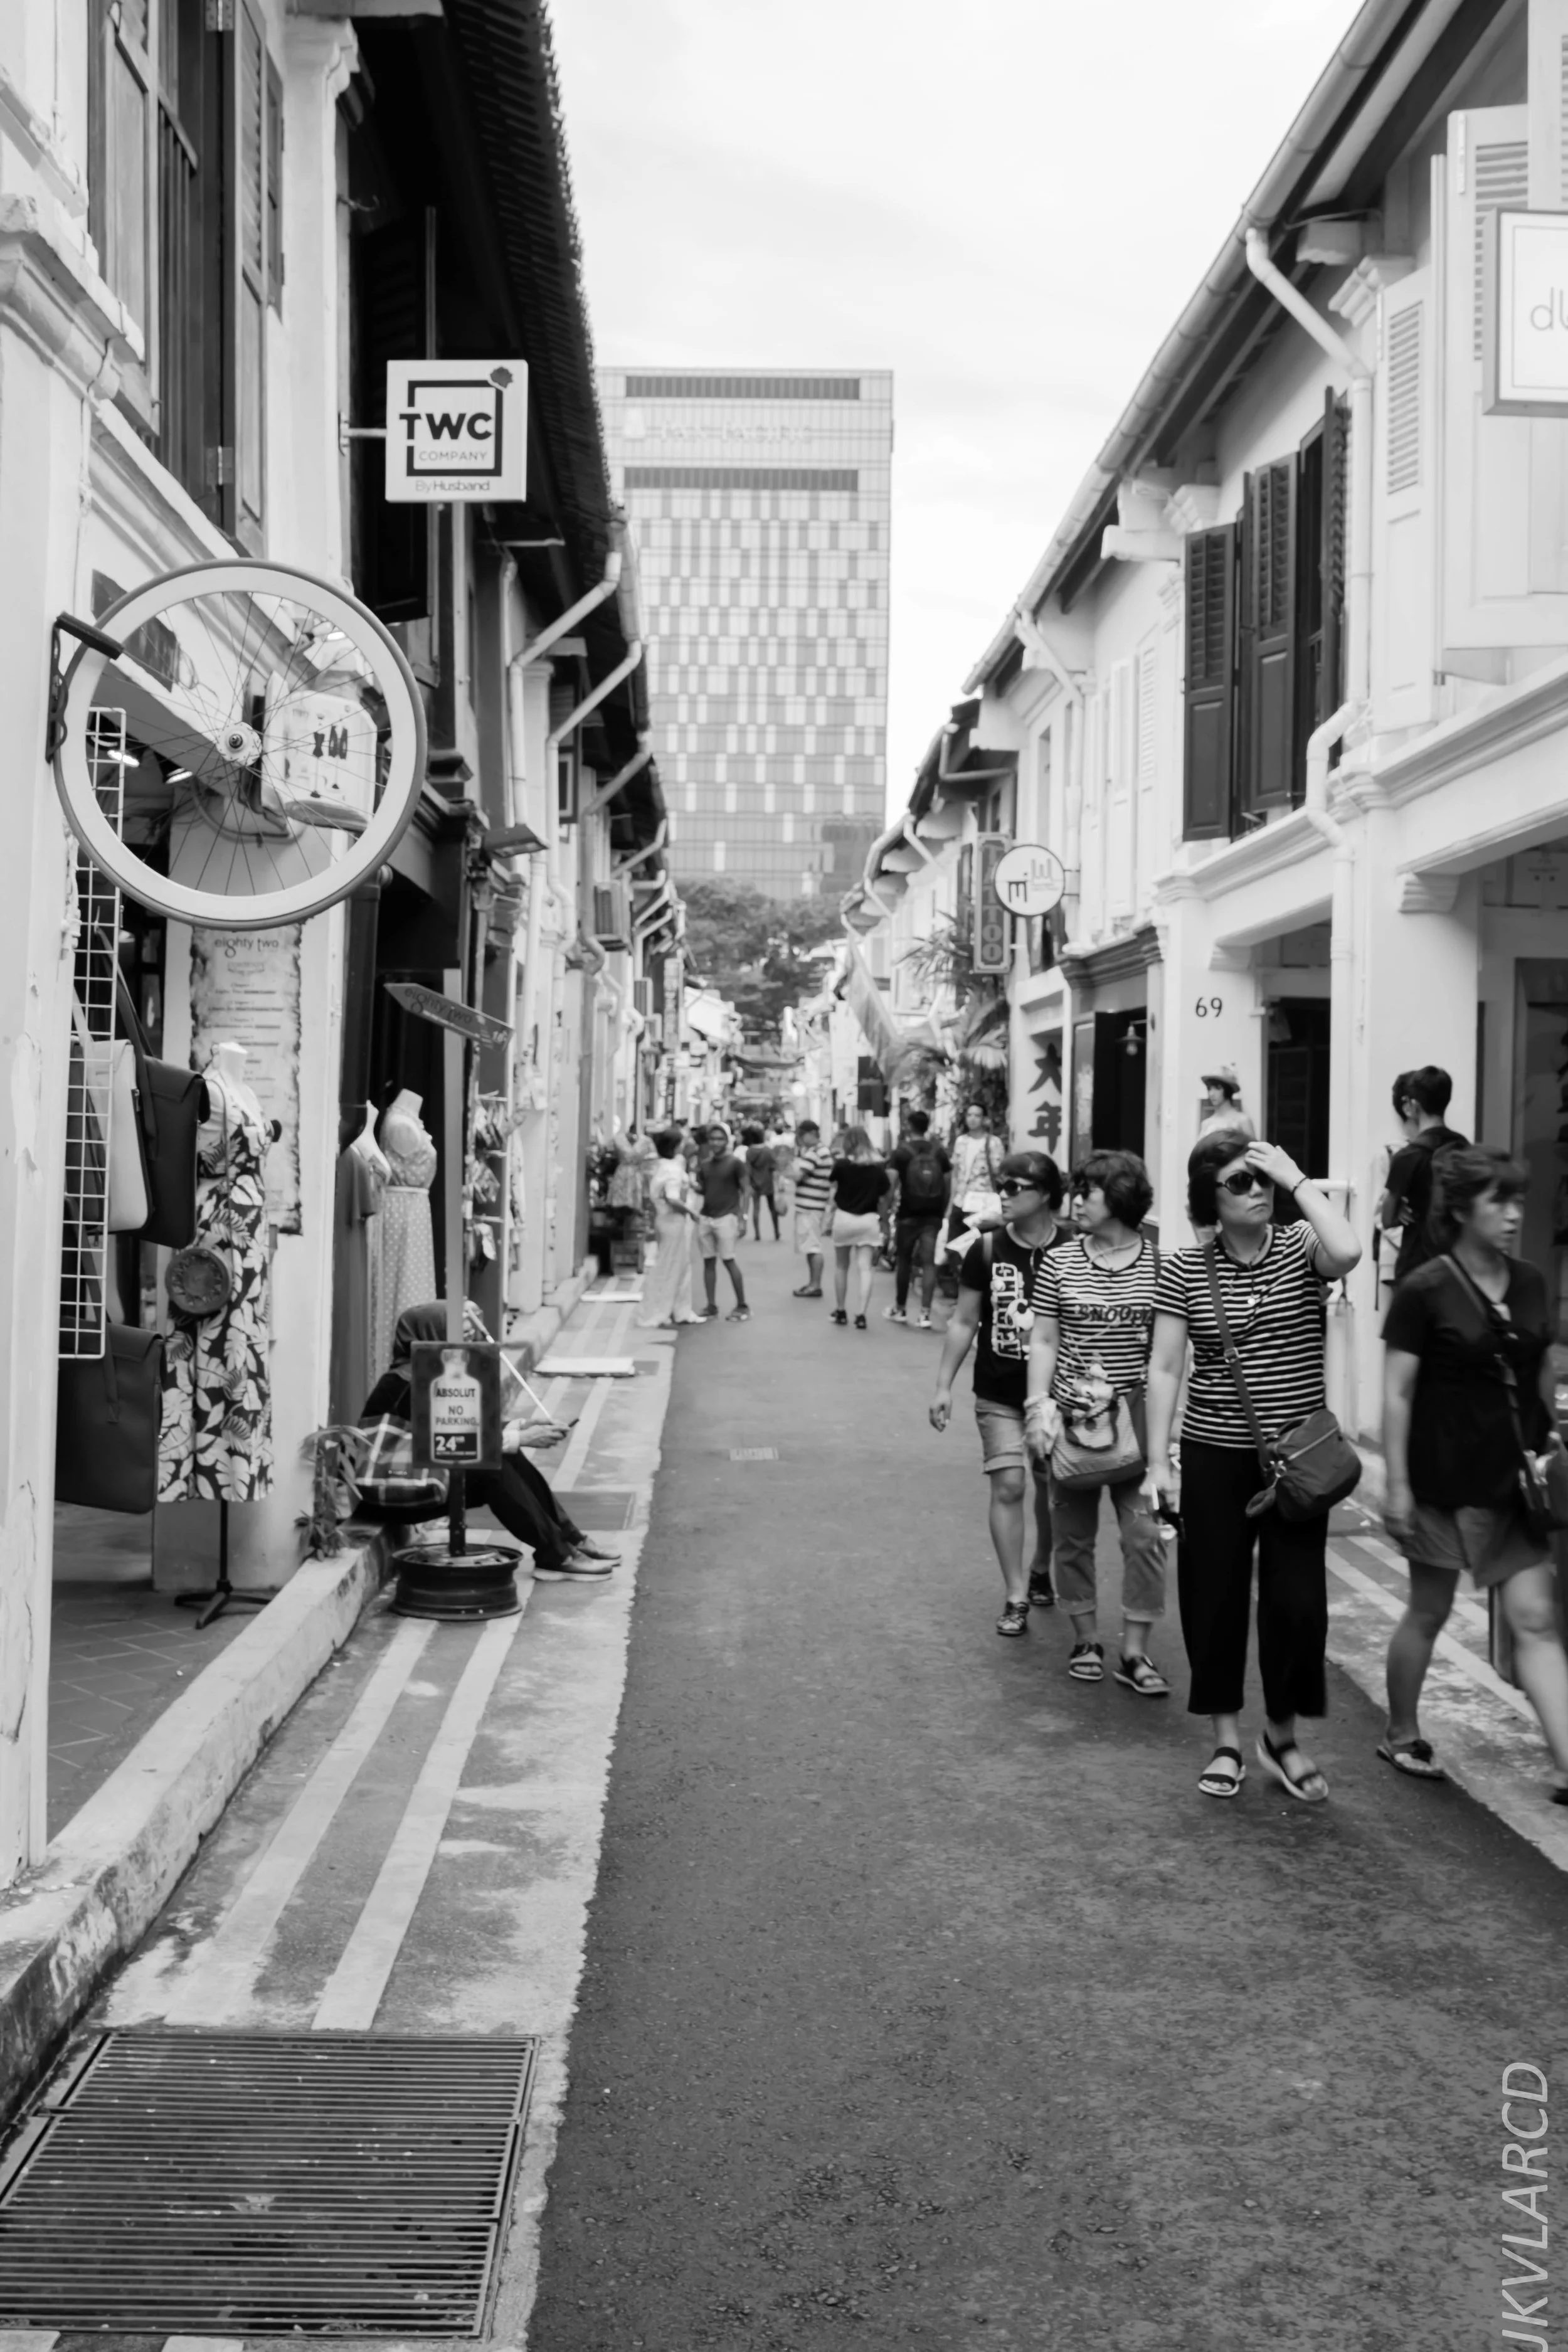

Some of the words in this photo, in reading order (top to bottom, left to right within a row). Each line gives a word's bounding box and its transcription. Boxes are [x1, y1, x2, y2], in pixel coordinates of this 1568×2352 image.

[400, 412, 492, 440] TWC
[419, 451, 487, 462] COMPANY
[415, 480, 432, 494] By
[433, 480, 490, 492] Husband
[257, 938, 279, 952] two
[1195, 997, 1222, 1017] 69
[436, 1388, 475, 1397] ABSOLUT
[448, 1406, 464, 1415] NO
